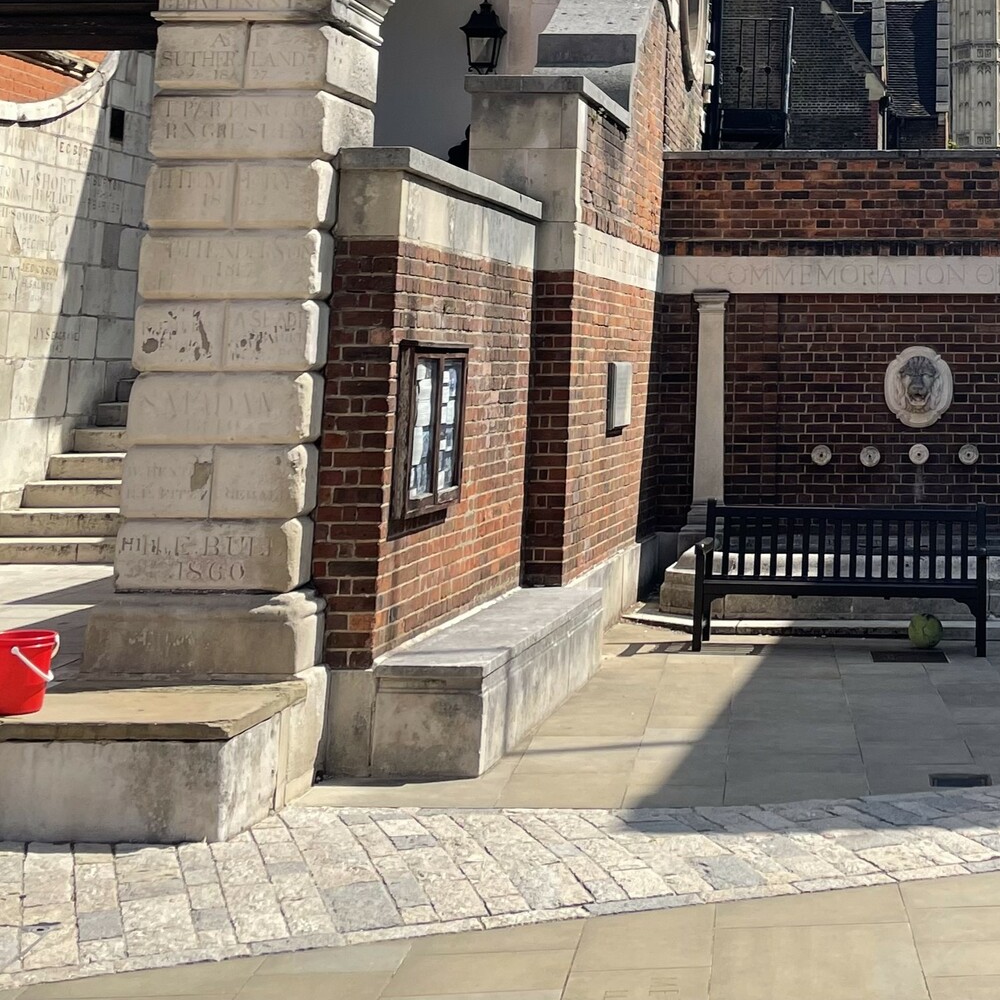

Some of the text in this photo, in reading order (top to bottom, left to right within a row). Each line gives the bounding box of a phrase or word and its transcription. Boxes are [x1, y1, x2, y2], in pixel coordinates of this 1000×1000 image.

[670, 264, 699, 286] IN
[707, 263, 967, 287] COMMEMORATION
[176, 562, 246, 582] 1860
